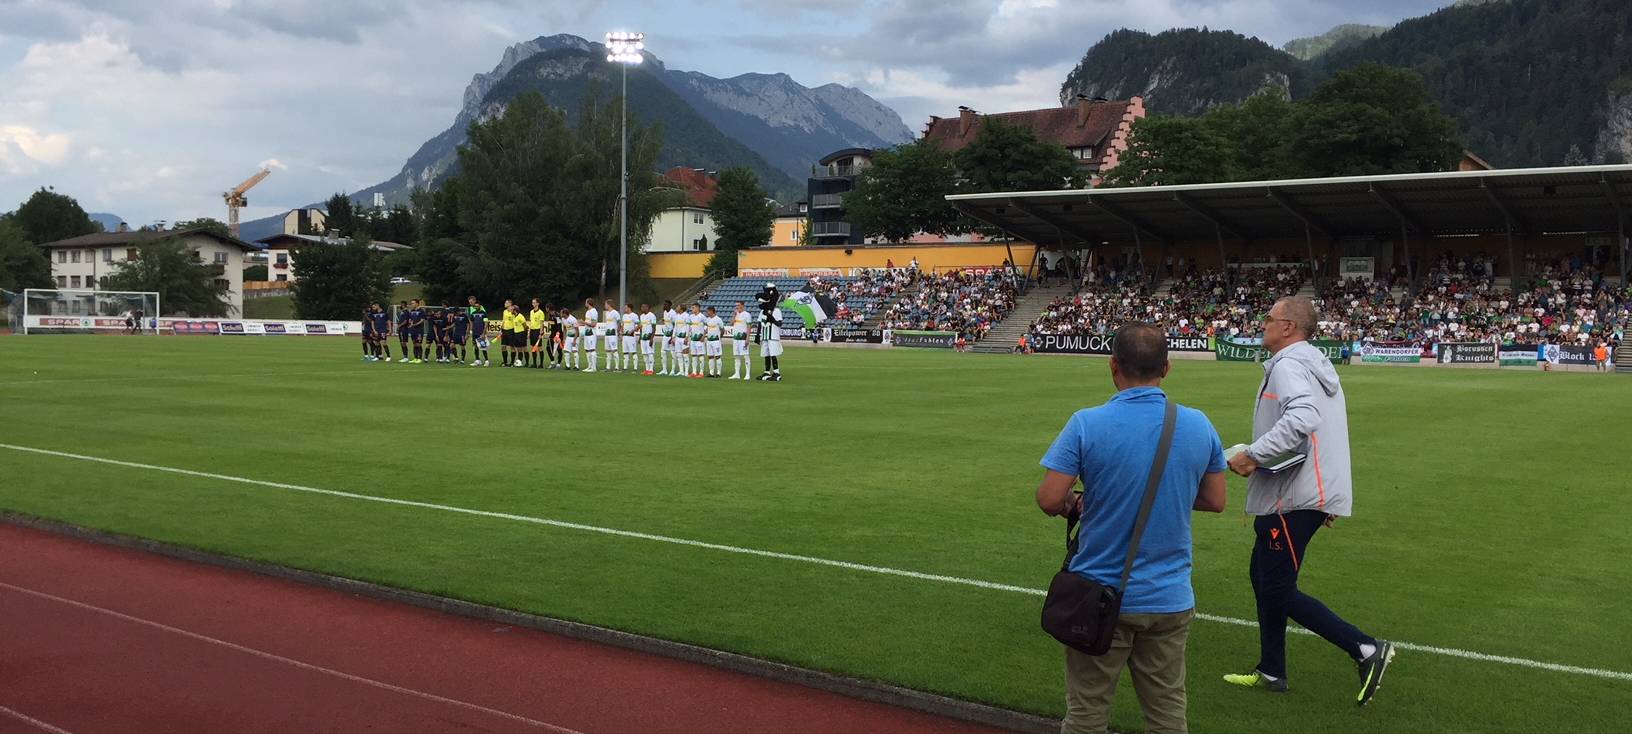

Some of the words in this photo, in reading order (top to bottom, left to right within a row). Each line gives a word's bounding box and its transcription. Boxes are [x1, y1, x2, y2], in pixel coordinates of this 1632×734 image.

[965, 268, 1003, 278] SPA
[1045, 335, 1112, 351] PUMUCK
[1559, 351, 1585, 361] Block
